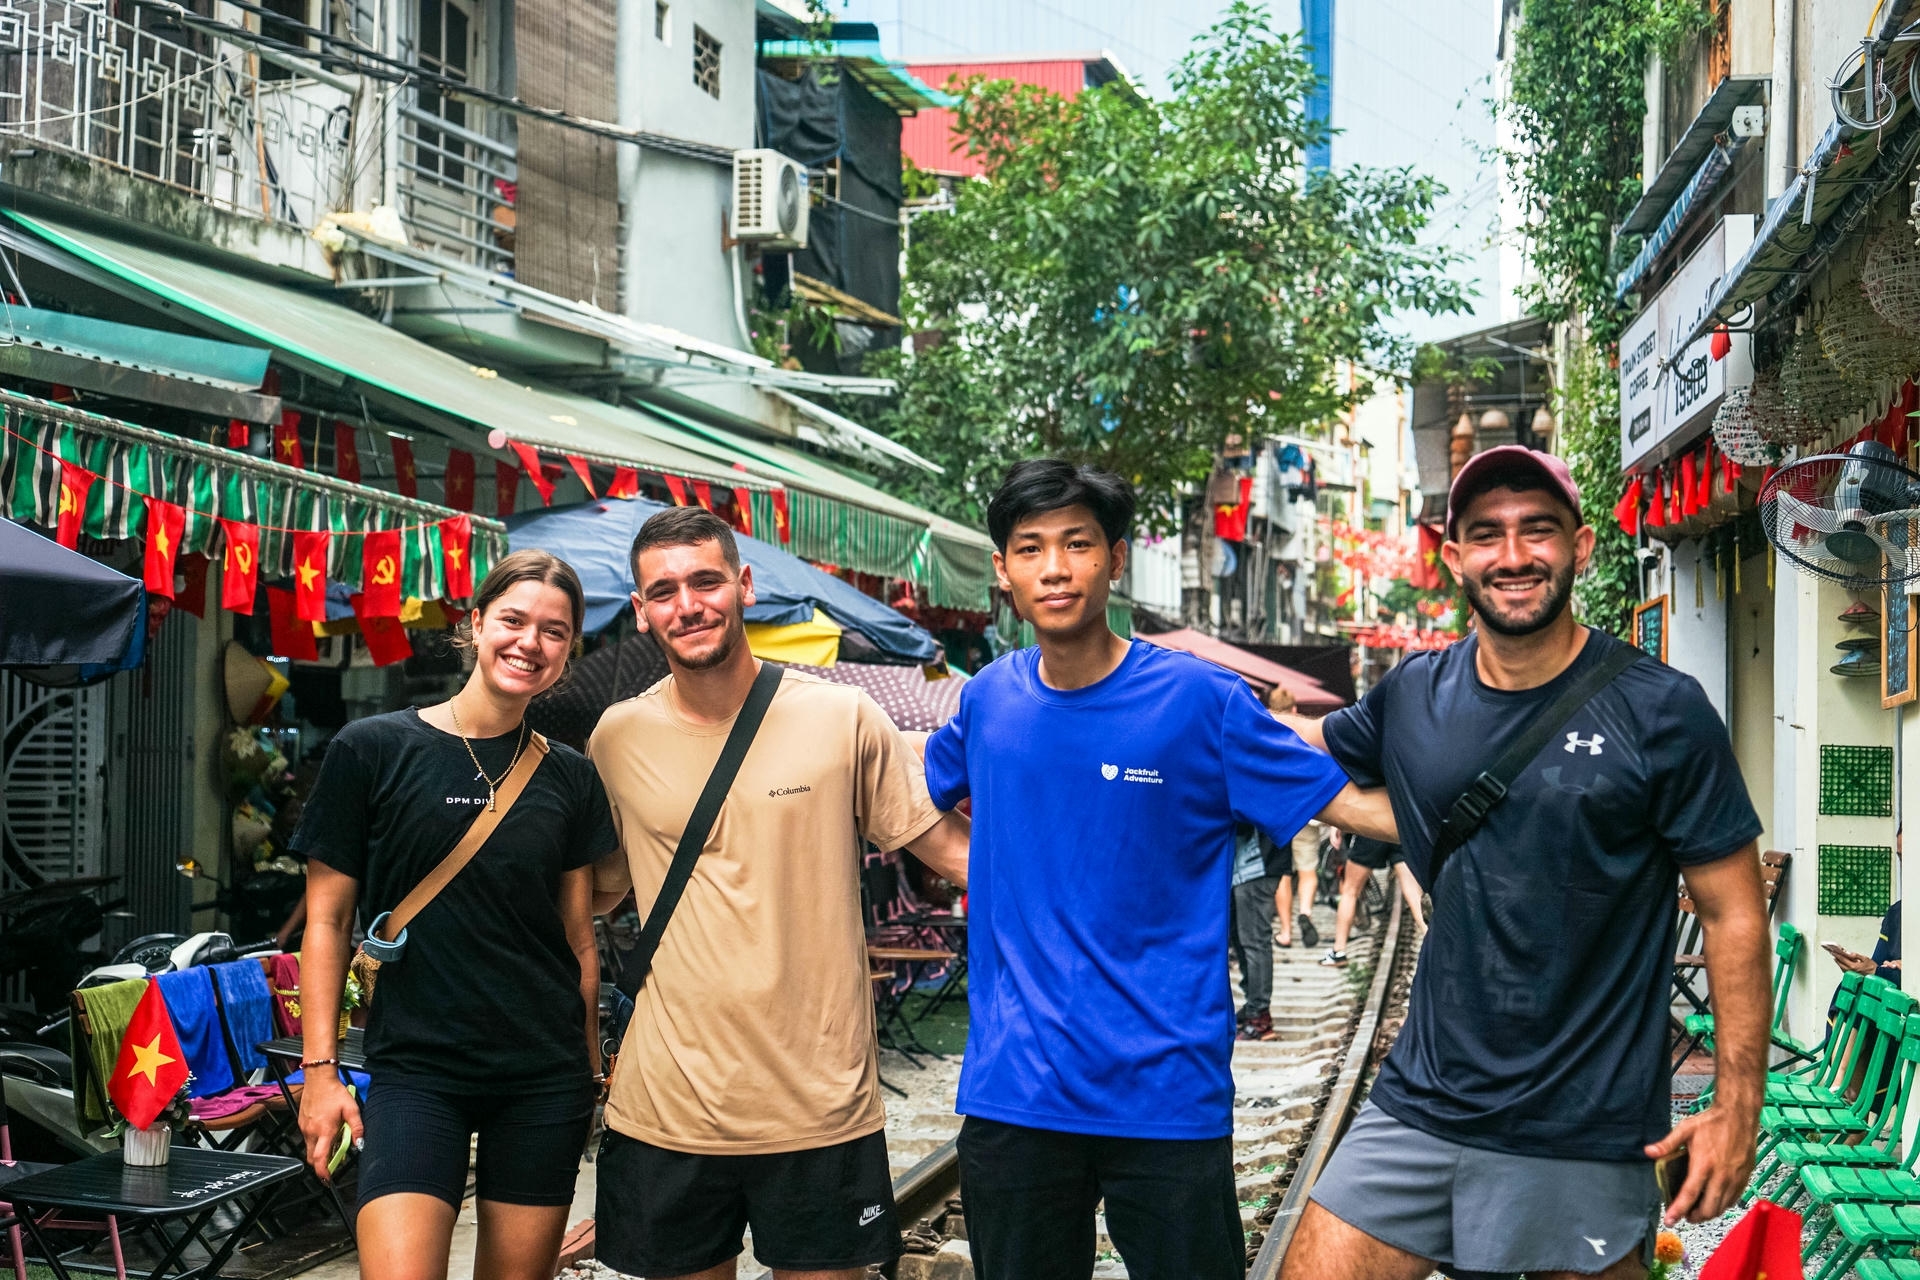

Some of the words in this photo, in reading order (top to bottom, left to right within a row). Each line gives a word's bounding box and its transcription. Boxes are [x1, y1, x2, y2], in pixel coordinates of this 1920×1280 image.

[1622, 350, 1637, 379] TRAIN
[1637, 330, 1656, 366] STREET
[1629, 367, 1649, 400] COFFEE
[1124, 767, 1159, 777] Jackfruit
[1123, 774, 1164, 784] Adventure
[776, 785, 811, 796] Columbia
[862, 1204, 881, 1219] NIKE
